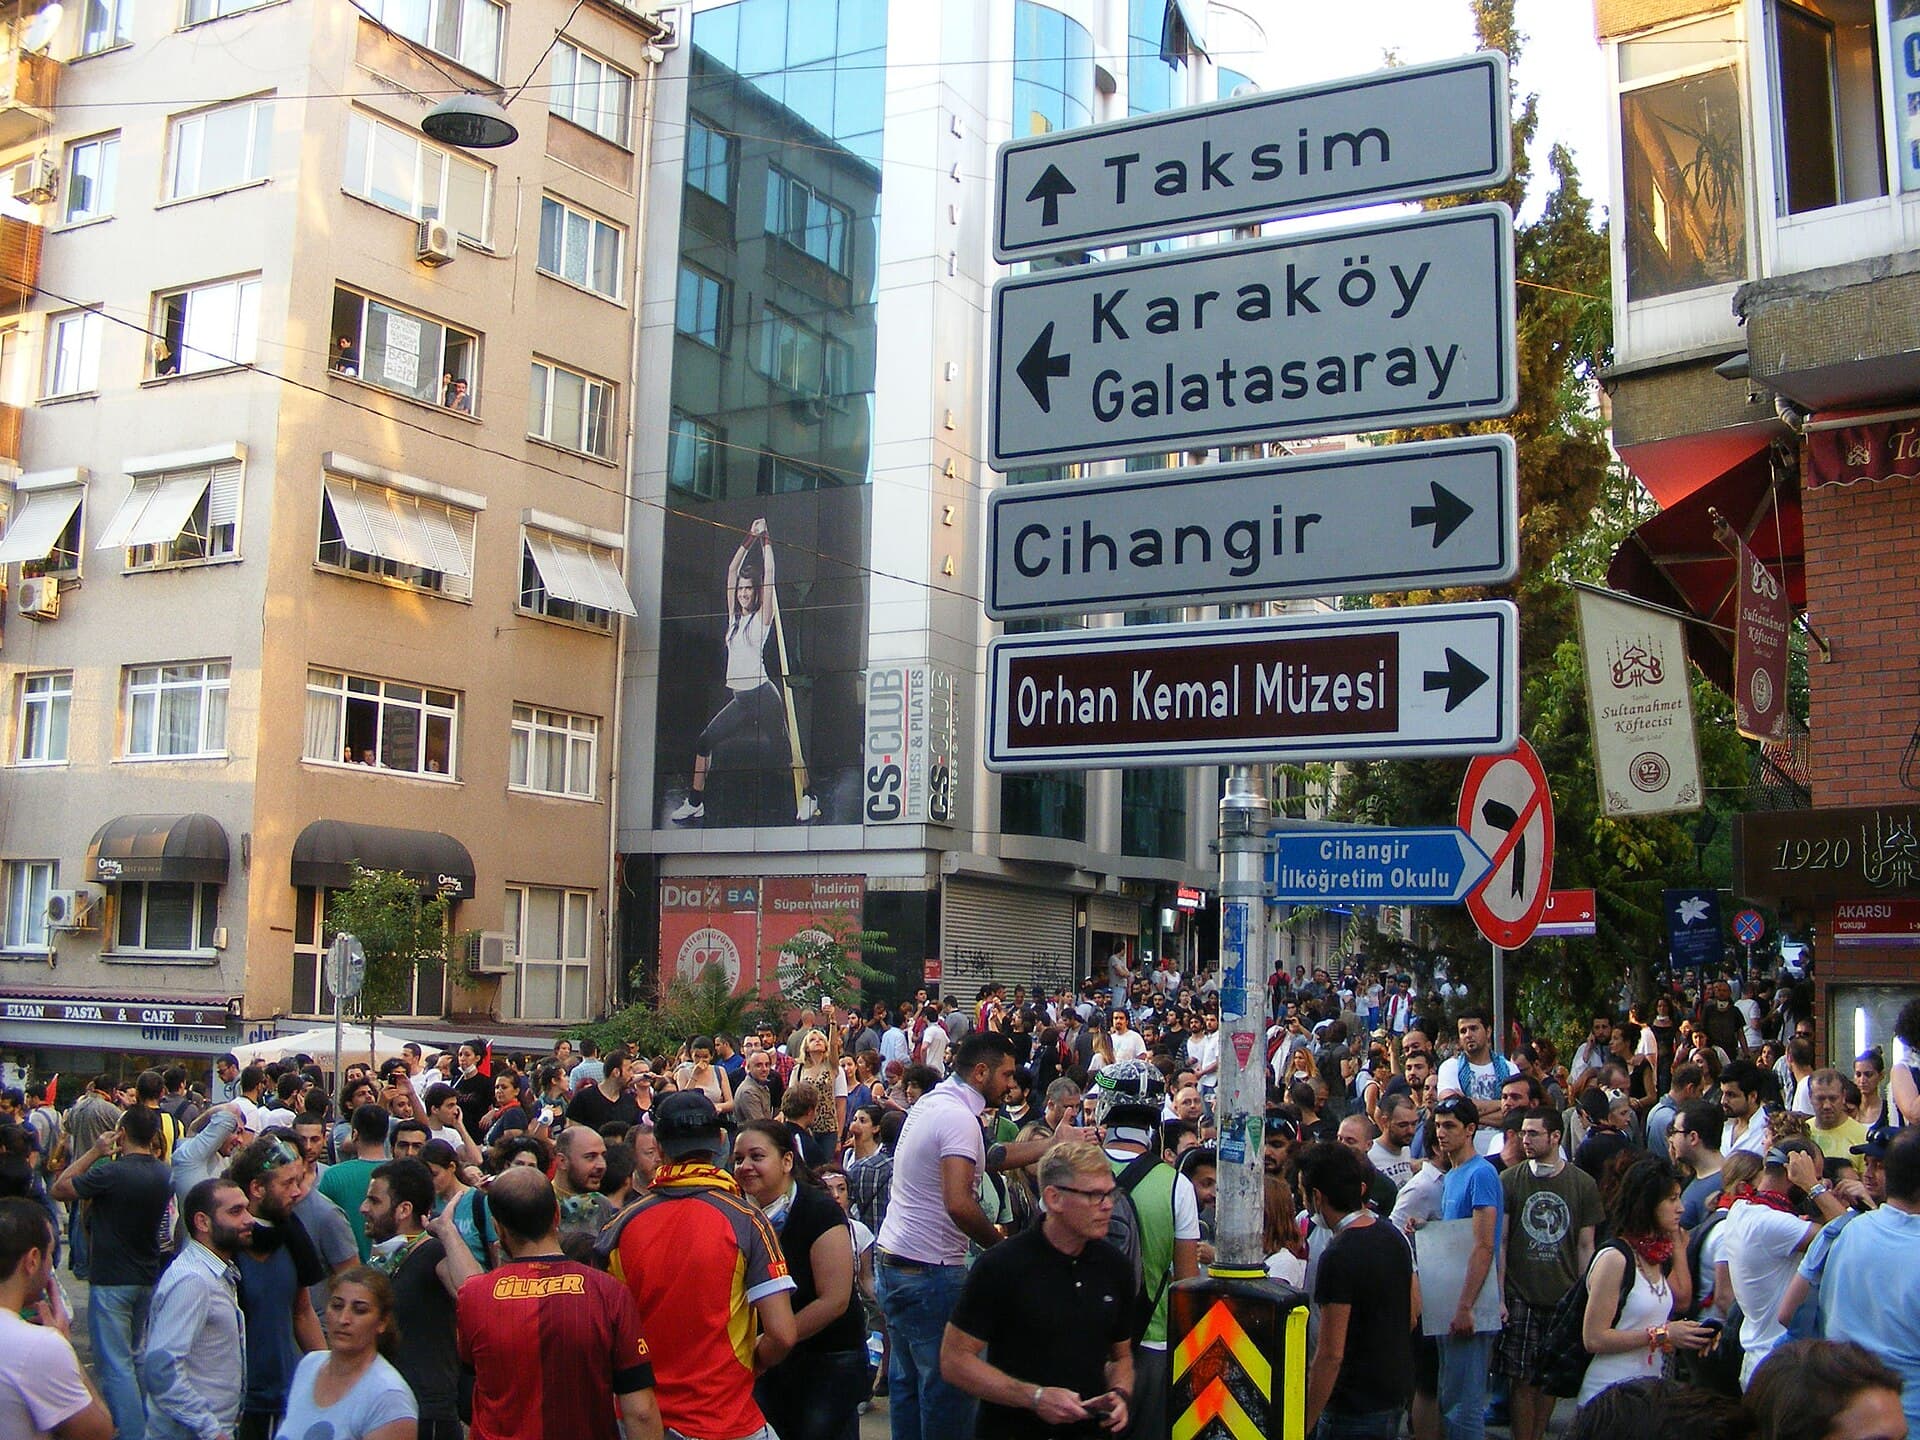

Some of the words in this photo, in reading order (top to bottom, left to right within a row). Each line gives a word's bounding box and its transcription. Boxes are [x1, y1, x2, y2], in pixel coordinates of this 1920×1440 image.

[1104, 126, 1390, 204] Taksim
[1092, 254, 1431, 344] Karaköy
[1092, 343, 1458, 423] Galatasaray
[943, 360, 958, 577] PLAZA
[1013, 504, 1322, 579] Cihangir
[911, 669, 924, 731] PILATES
[1017, 674, 1117, 728] Orhan
[1131, 664, 1240, 721] Kemal
[1255, 659, 1385, 715] Müzesi
[1601, 699, 1682, 720] Sultanahmet
[1614, 714, 1673, 734] Köftecisi
[910, 735, 923, 748] &
[909, 752, 922, 817] FITNESS
[1320, 840, 1410, 865] Cihangir
[1771, 838, 1850, 870] 1920
[815, 880, 860, 895] İndirim
[1282, 865, 1384, 893] İlköğretim
[1391, 867, 1449, 888] Okulu
[773, 896, 860, 912] Süpermarketi
[1837, 905, 1892, 918] AKARSU
[7, 1004, 45, 1018] ELVAN
[65, 1006, 103, 1020] PASTA
[118, 1007, 128, 1021] &
[142, 1010, 175, 1023] CAFE
[183, 1033, 240, 1045] PASTANELERİ
[493, 1273, 585, 1300] ÜLKER
